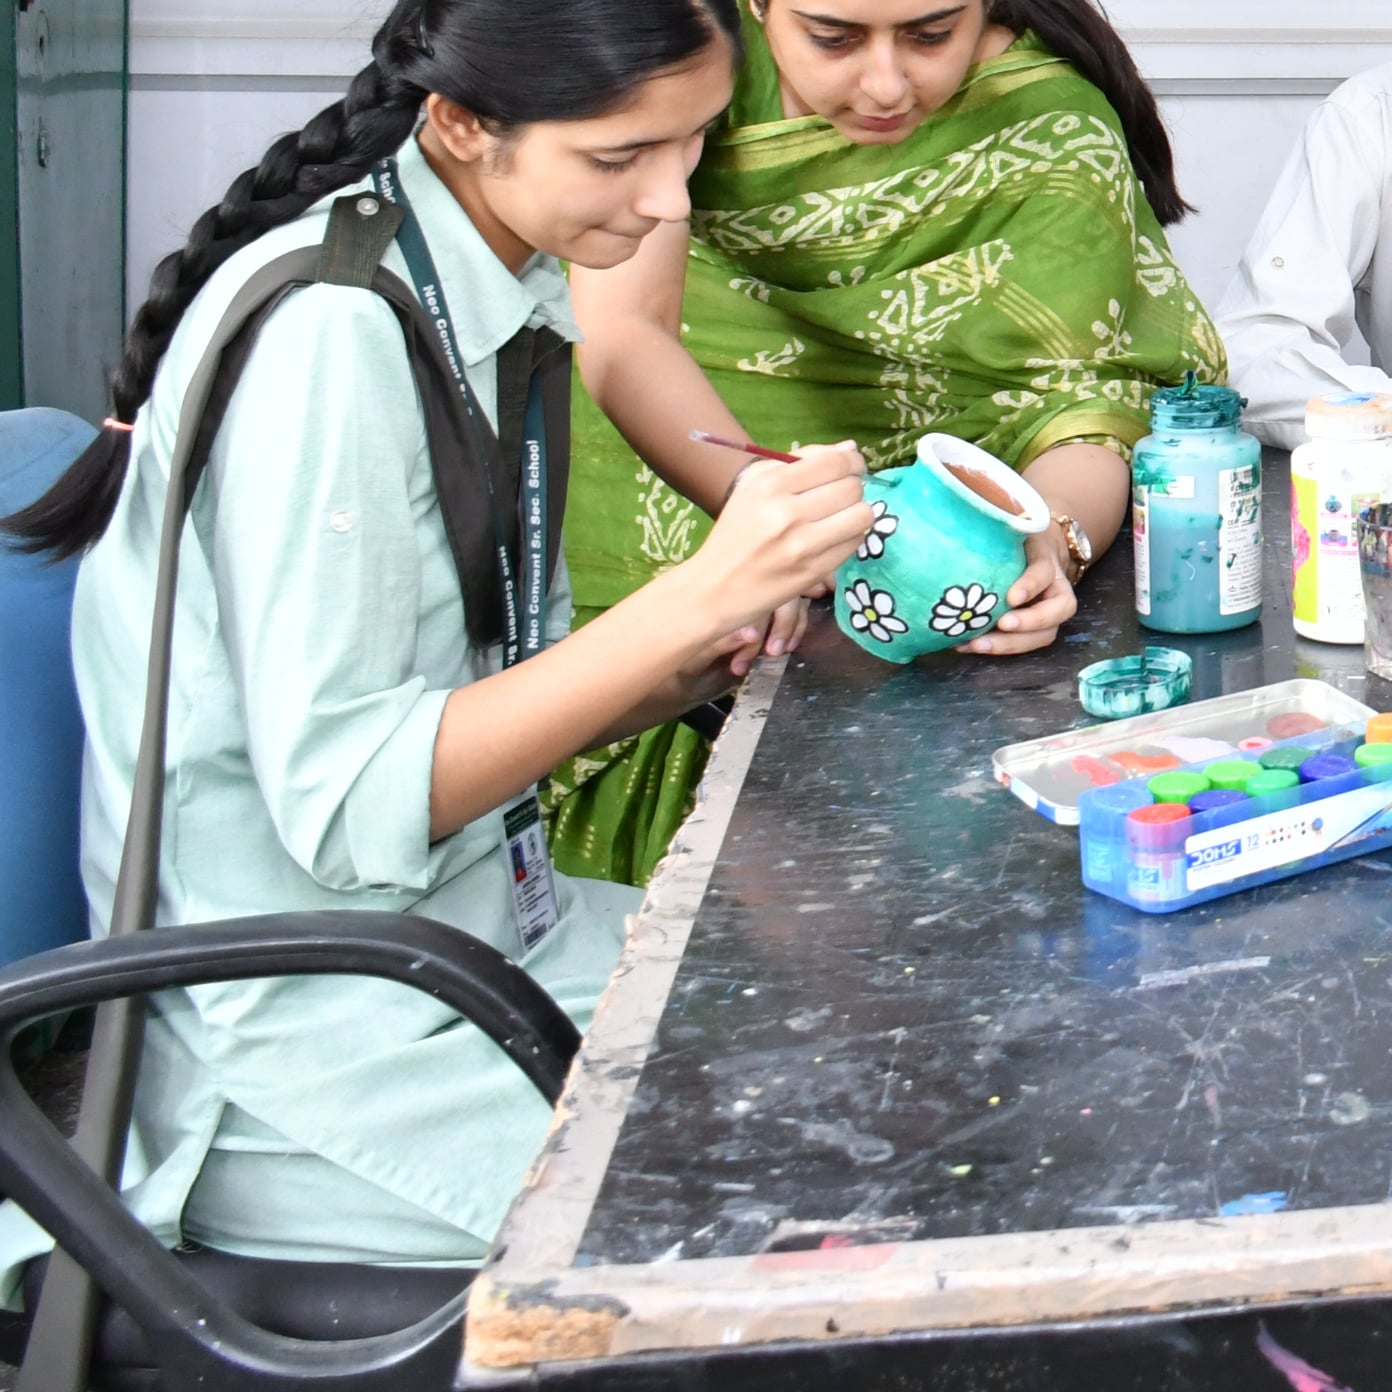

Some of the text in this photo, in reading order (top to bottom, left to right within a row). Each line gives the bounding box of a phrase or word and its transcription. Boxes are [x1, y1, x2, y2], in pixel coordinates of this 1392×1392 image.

[422, 284, 462, 380] Neo Convent
[526, 439, 541, 649] Neo Convent Sr. Sec. School
[498, 545, 509, 576] Neo
[505, 580, 518, 642] Convent
[1191, 834, 1260, 866] DOMS 12
